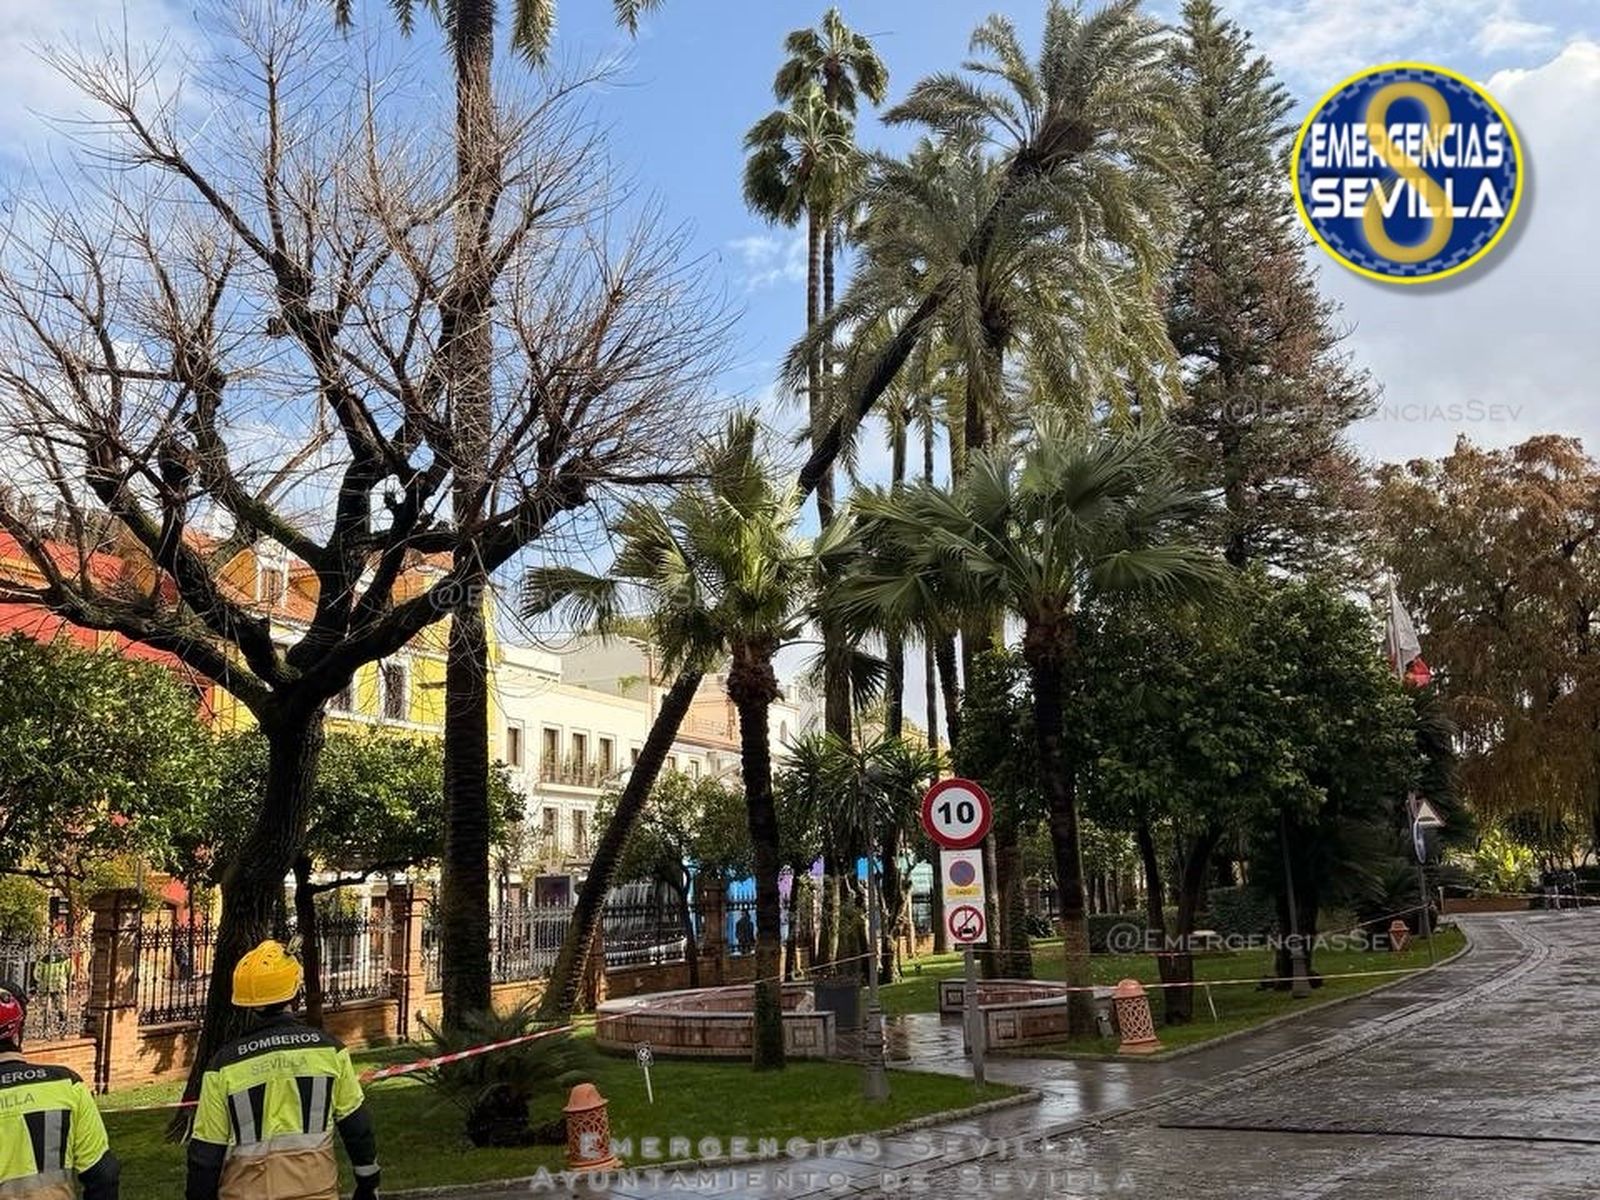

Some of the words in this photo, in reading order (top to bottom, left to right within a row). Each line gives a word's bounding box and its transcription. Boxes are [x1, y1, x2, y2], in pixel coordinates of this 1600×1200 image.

[938, 801, 975, 825] 10
[238, 1033, 320, 1056] BOMBEROS
[251, 1056, 307, 1076] SEVILLA
